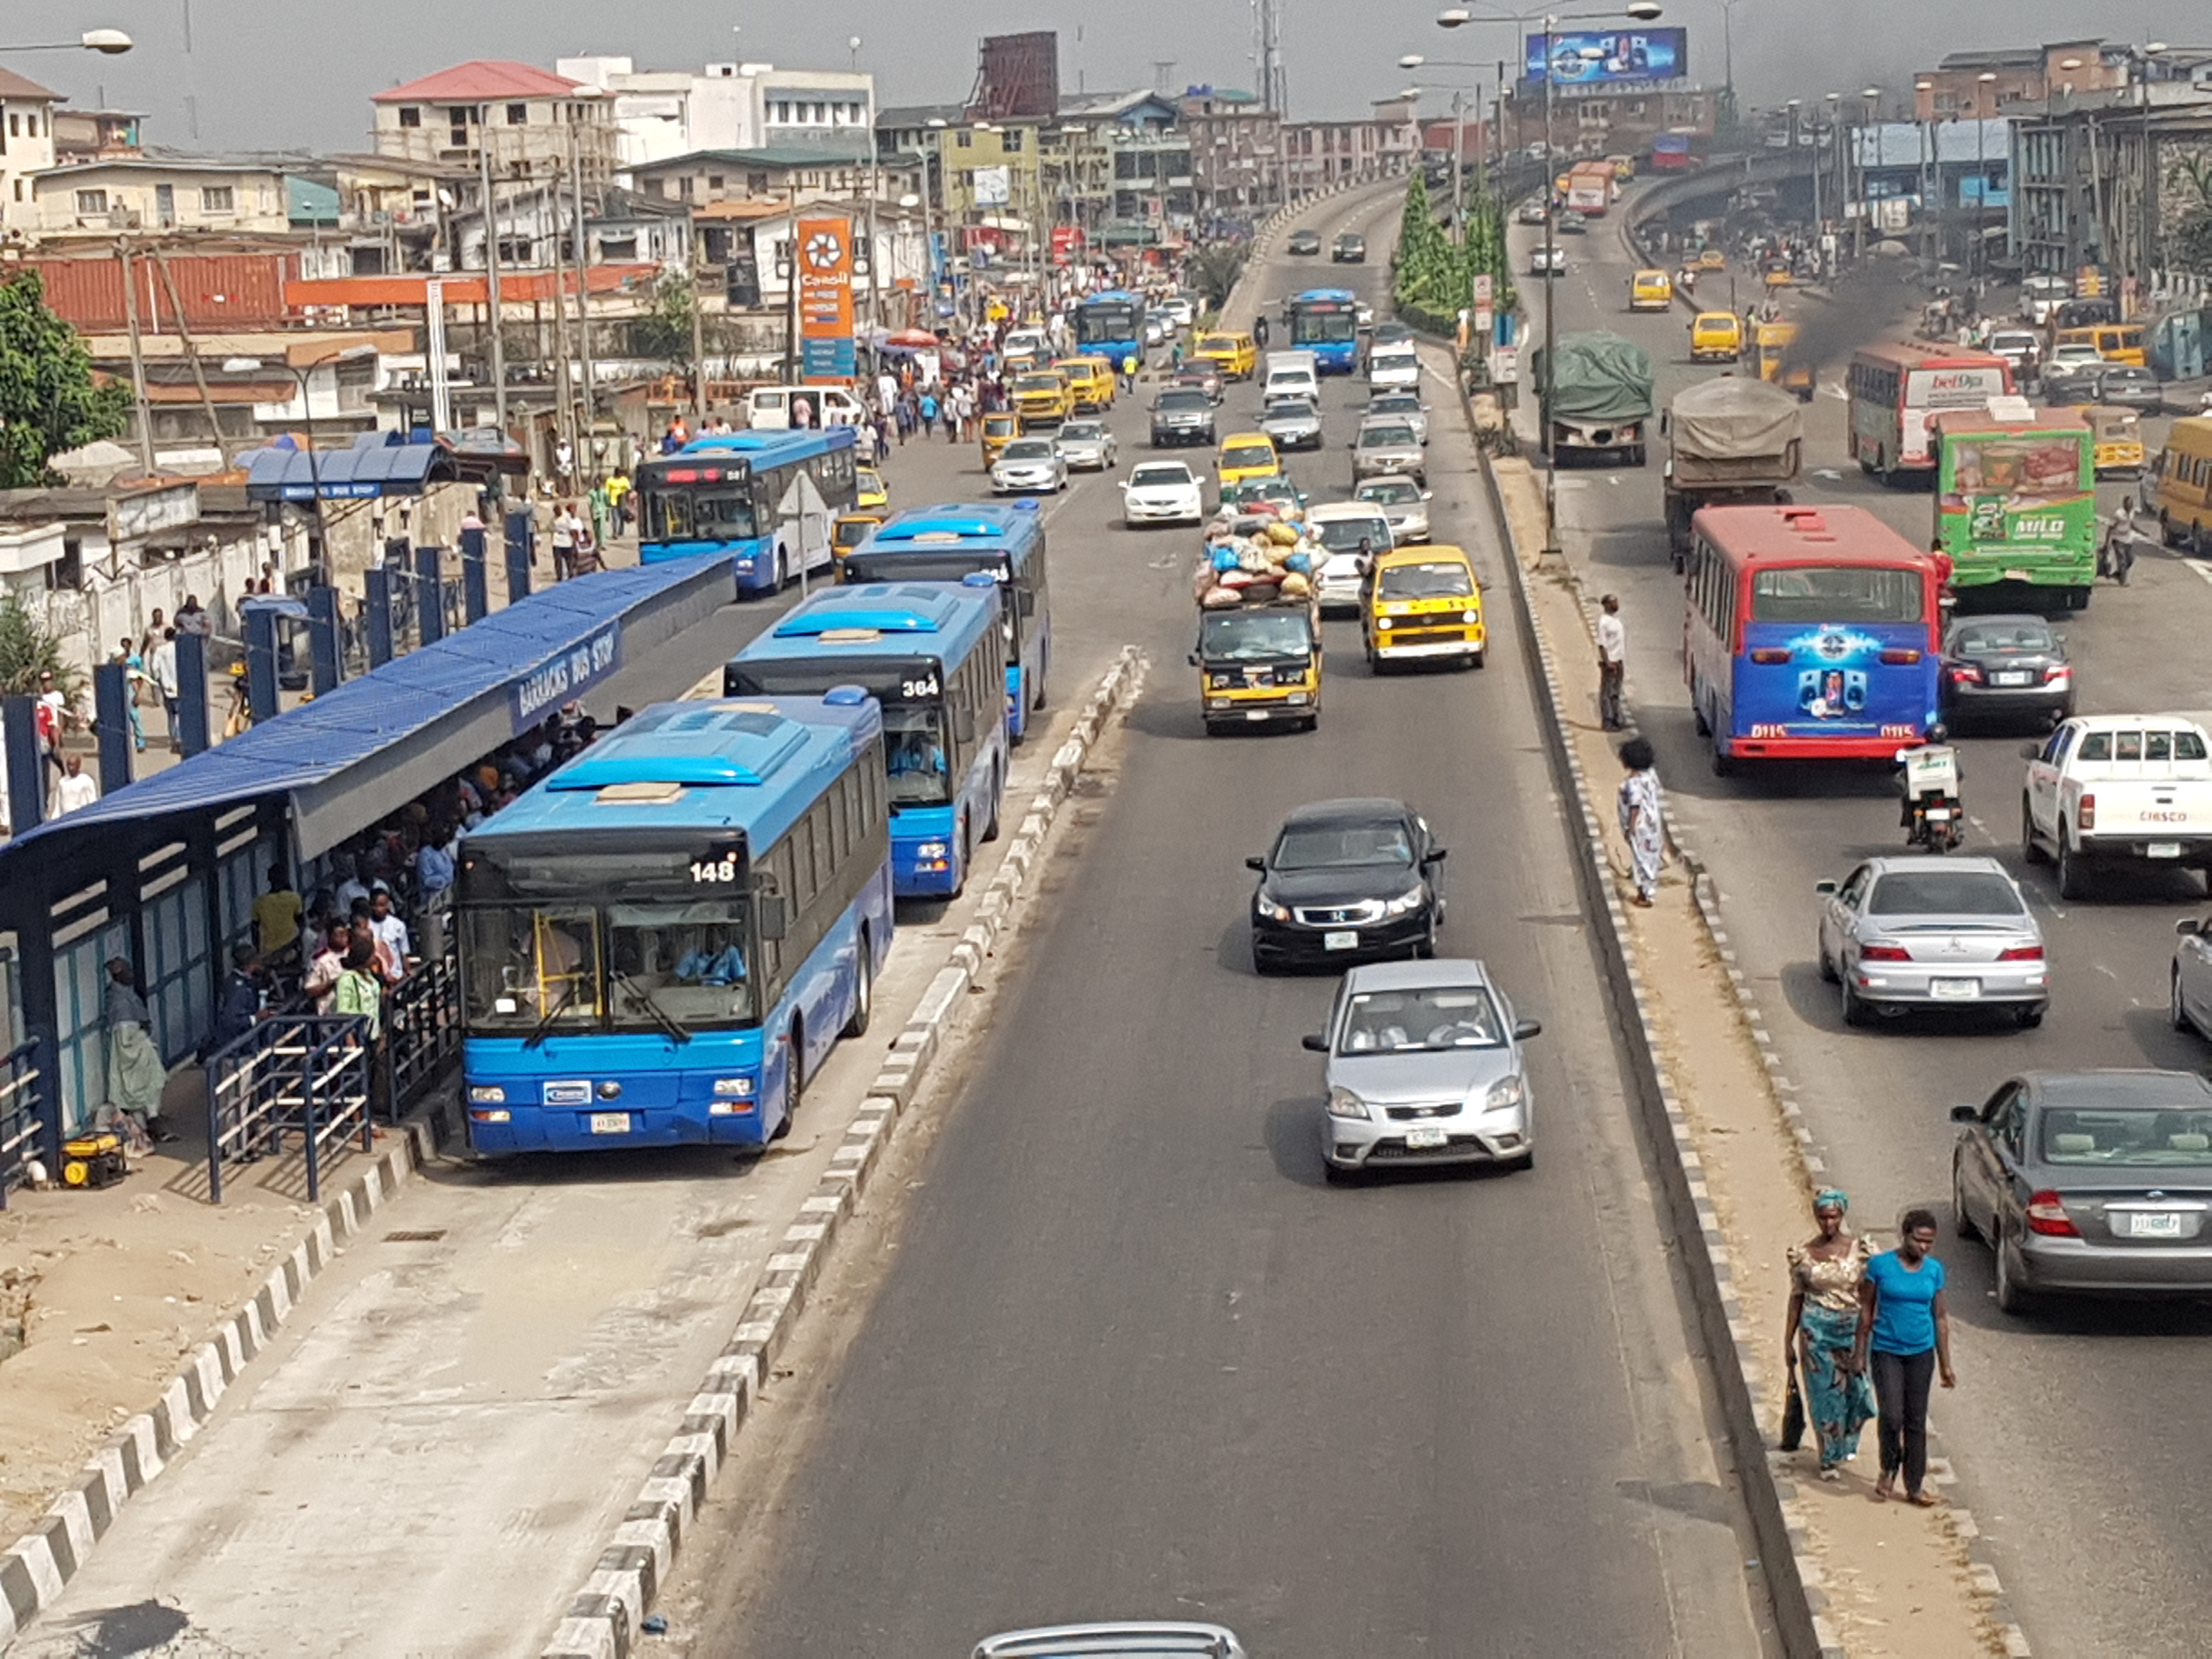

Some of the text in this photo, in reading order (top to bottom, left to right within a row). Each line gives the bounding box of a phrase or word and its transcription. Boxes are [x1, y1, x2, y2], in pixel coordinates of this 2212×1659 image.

[2015, 519, 2064, 532] MILO
[519, 632, 614, 719] BARRACKS BUS STOP
[902, 679, 939, 697] 364
[690, 860, 735, 882] 148
